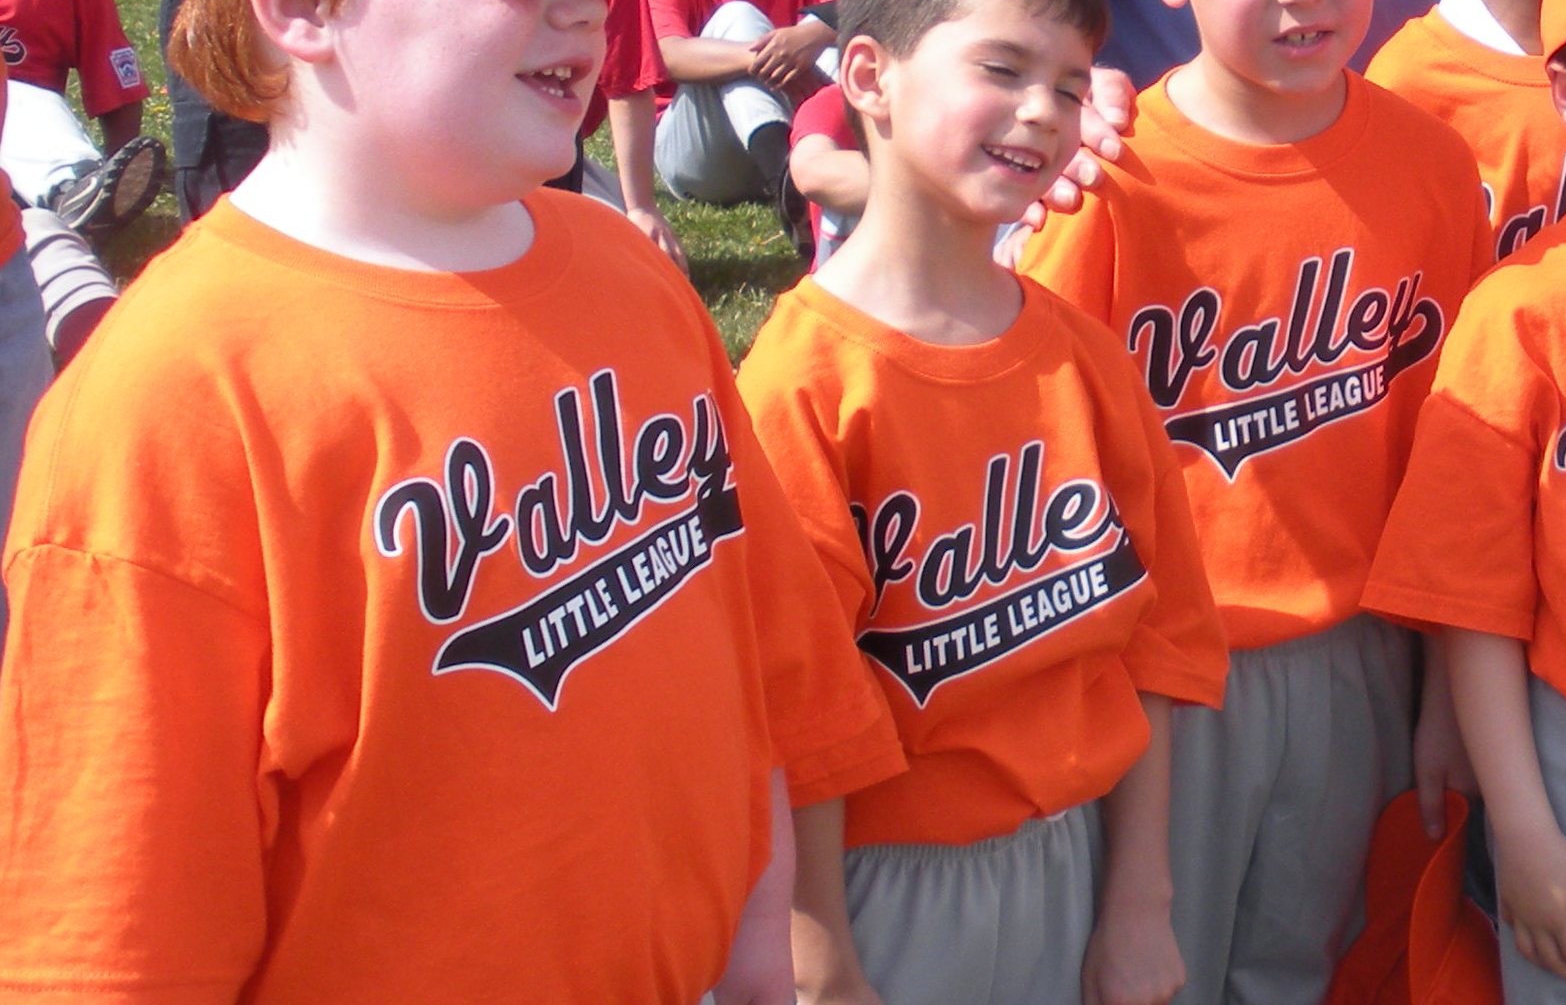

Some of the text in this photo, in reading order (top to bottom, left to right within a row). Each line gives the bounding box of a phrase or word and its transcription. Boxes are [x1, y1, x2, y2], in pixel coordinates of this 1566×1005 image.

[1129, 248, 1440, 409] Valley
[1214, 366, 1385, 452] LITTLE LEAGUE
[375, 370, 733, 623] Valley
[850, 440, 1123, 619] Valle
[521, 515, 708, 669] LITTLE LEAGUE
[905, 562, 1109, 675] LITTLE LEAGUE
